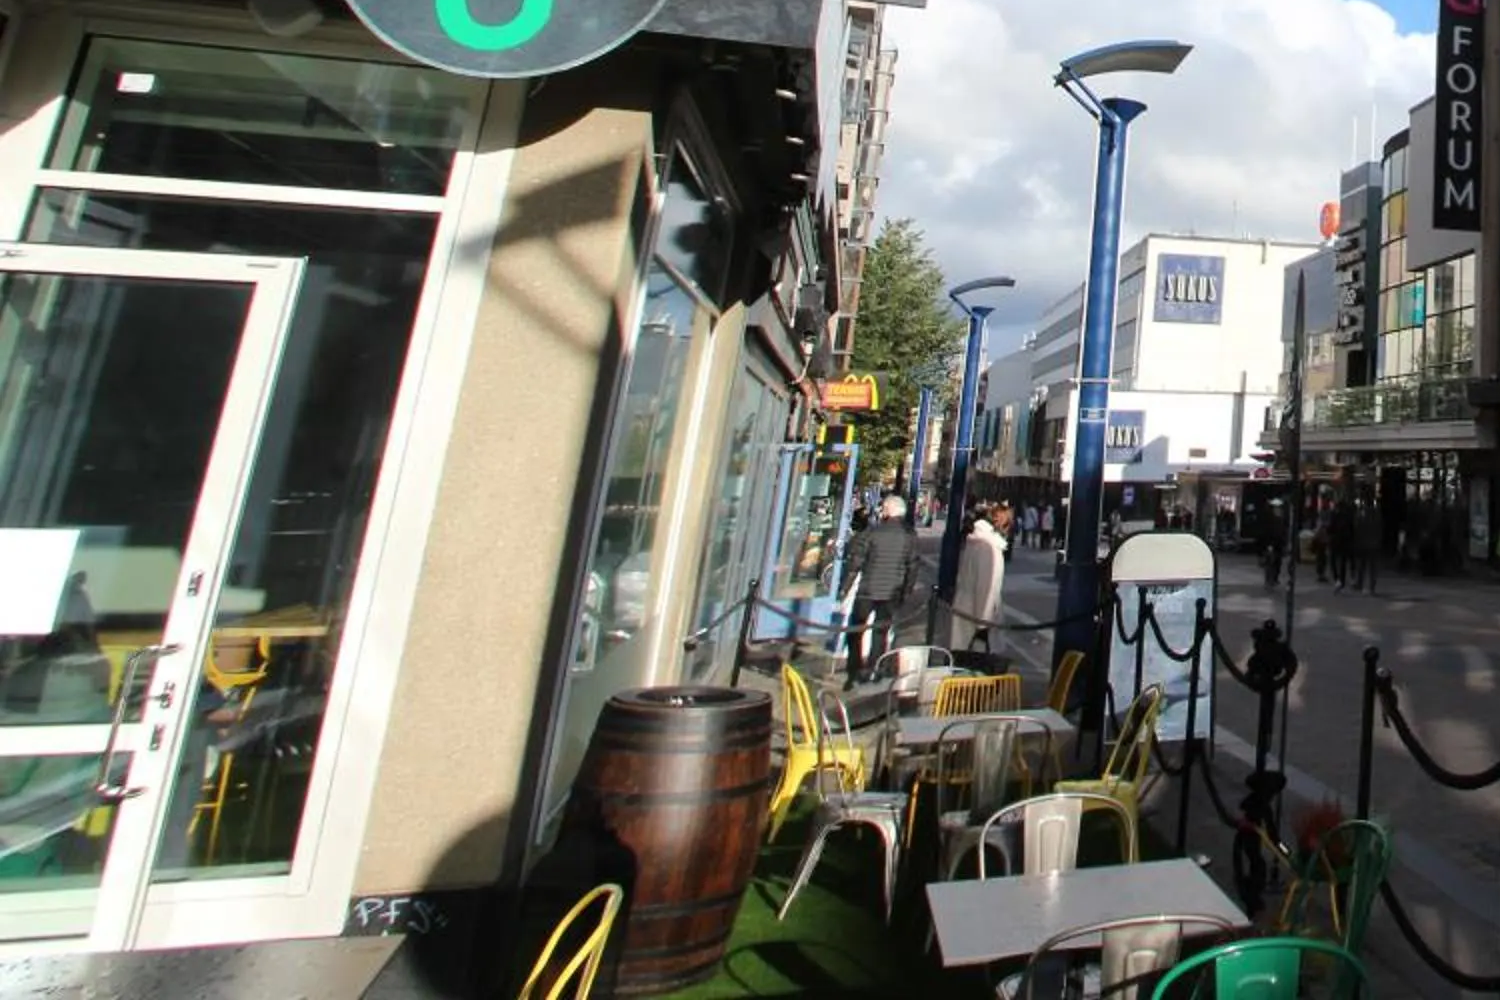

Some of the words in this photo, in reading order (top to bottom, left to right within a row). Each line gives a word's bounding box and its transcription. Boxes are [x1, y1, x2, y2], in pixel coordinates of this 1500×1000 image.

[1443, 25, 1477, 211] FORUM
[1164, 273, 1218, 303] SOKOS
[1107, 425, 1141, 449] OKOS
